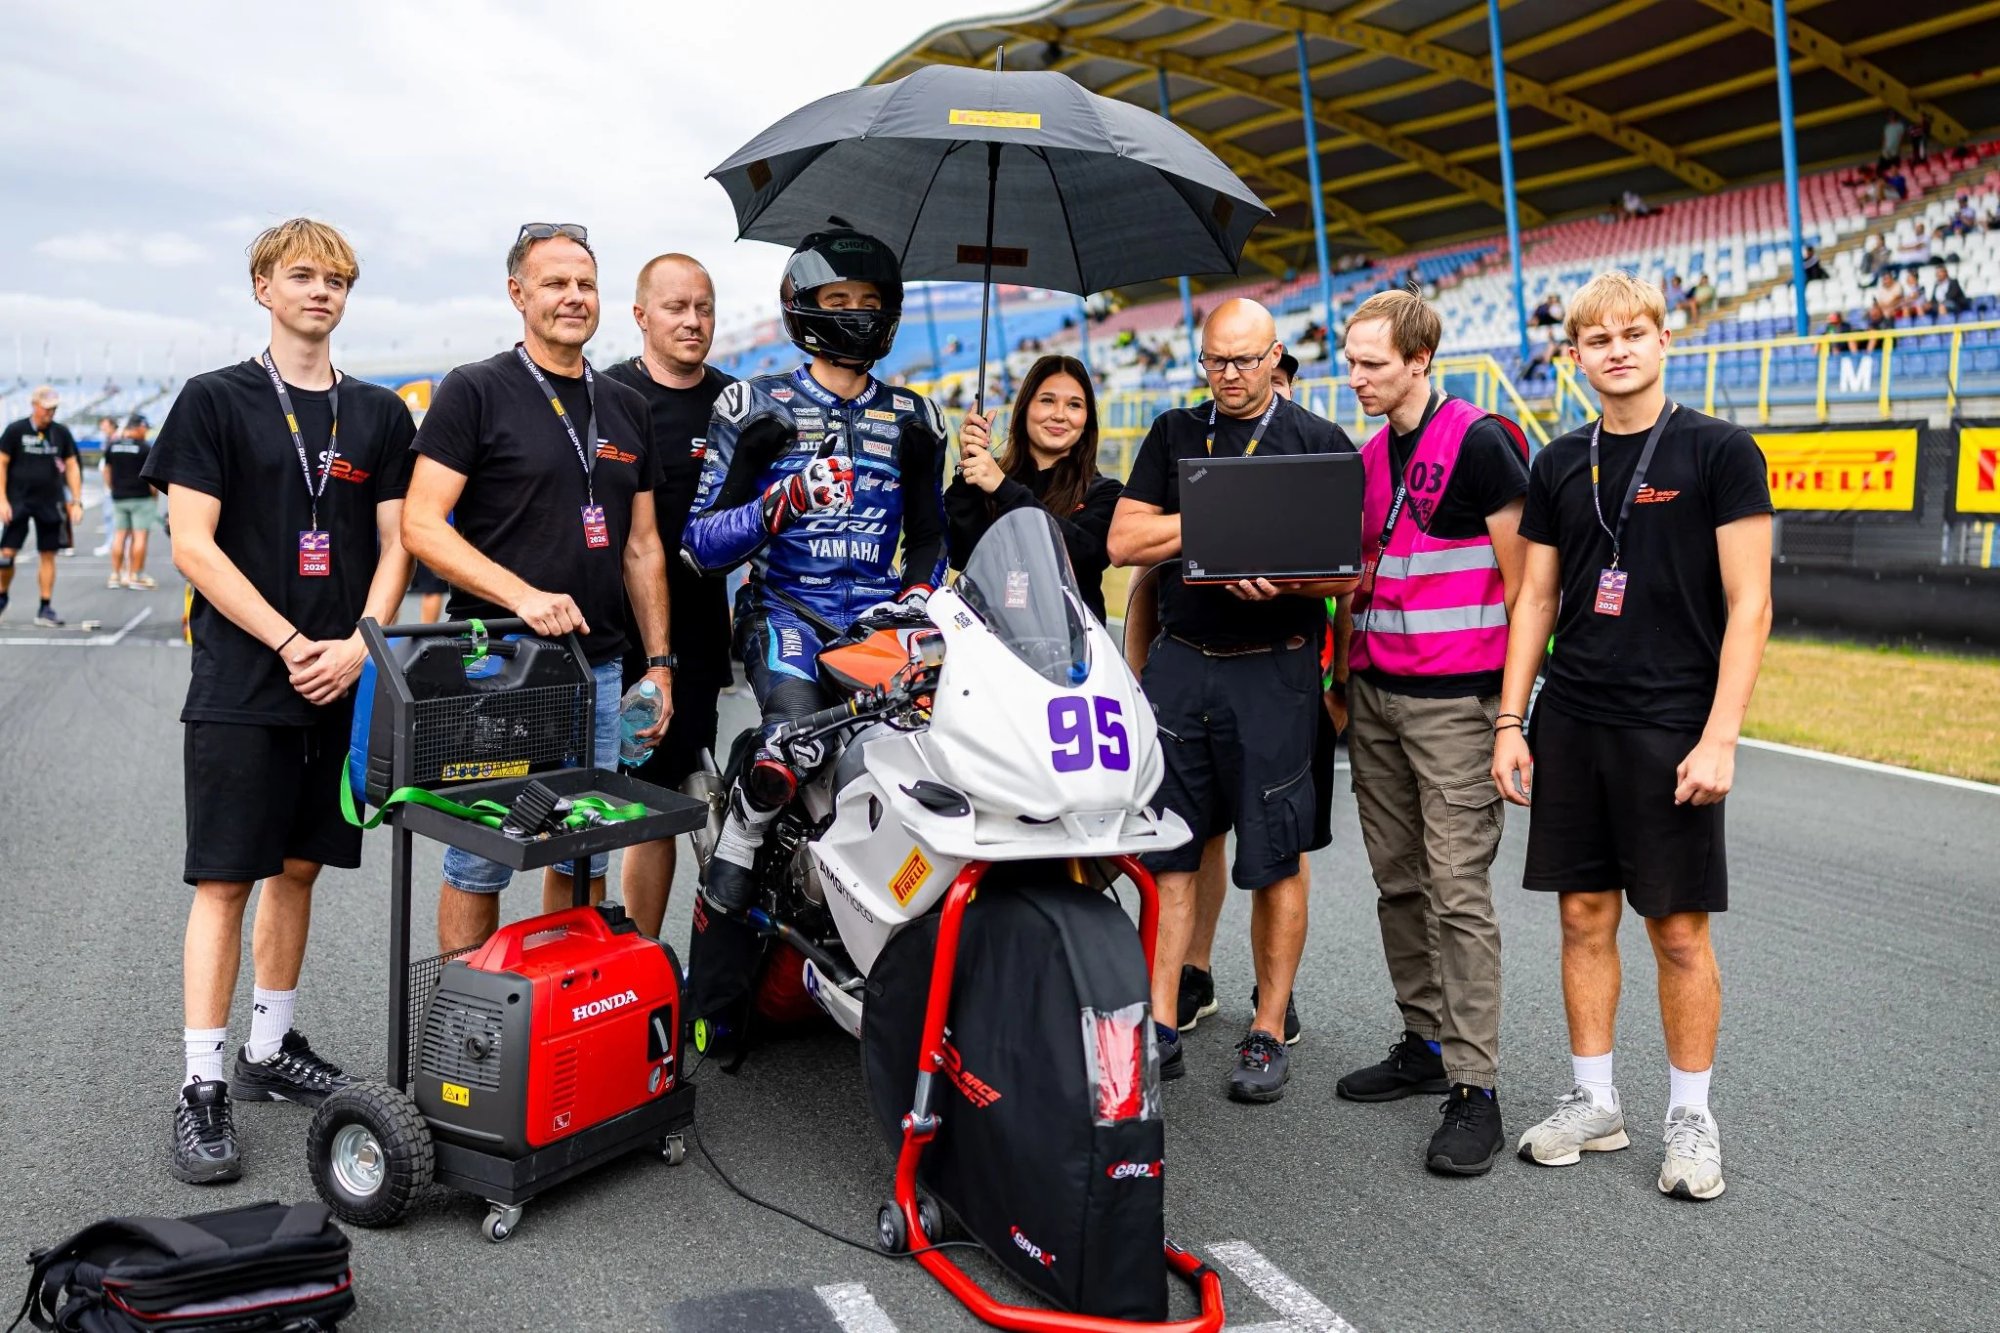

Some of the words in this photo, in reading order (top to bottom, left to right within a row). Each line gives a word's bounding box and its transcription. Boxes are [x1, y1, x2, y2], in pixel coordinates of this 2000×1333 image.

[1839, 355, 1873, 393] M
[1410, 461, 1444, 494] 03
[1387, 508, 1399, 529] EURO
[1395, 487, 1406, 509] MOTO
[303, 563, 327, 571] 2026
[808, 539, 880, 564] YAMAHA
[1598, 602, 1618, 611] 2026
[1047, 695, 1130, 773] 95
[893, 854, 927, 901] PIRELLI
[571, 989, 639, 1022] HONDA
